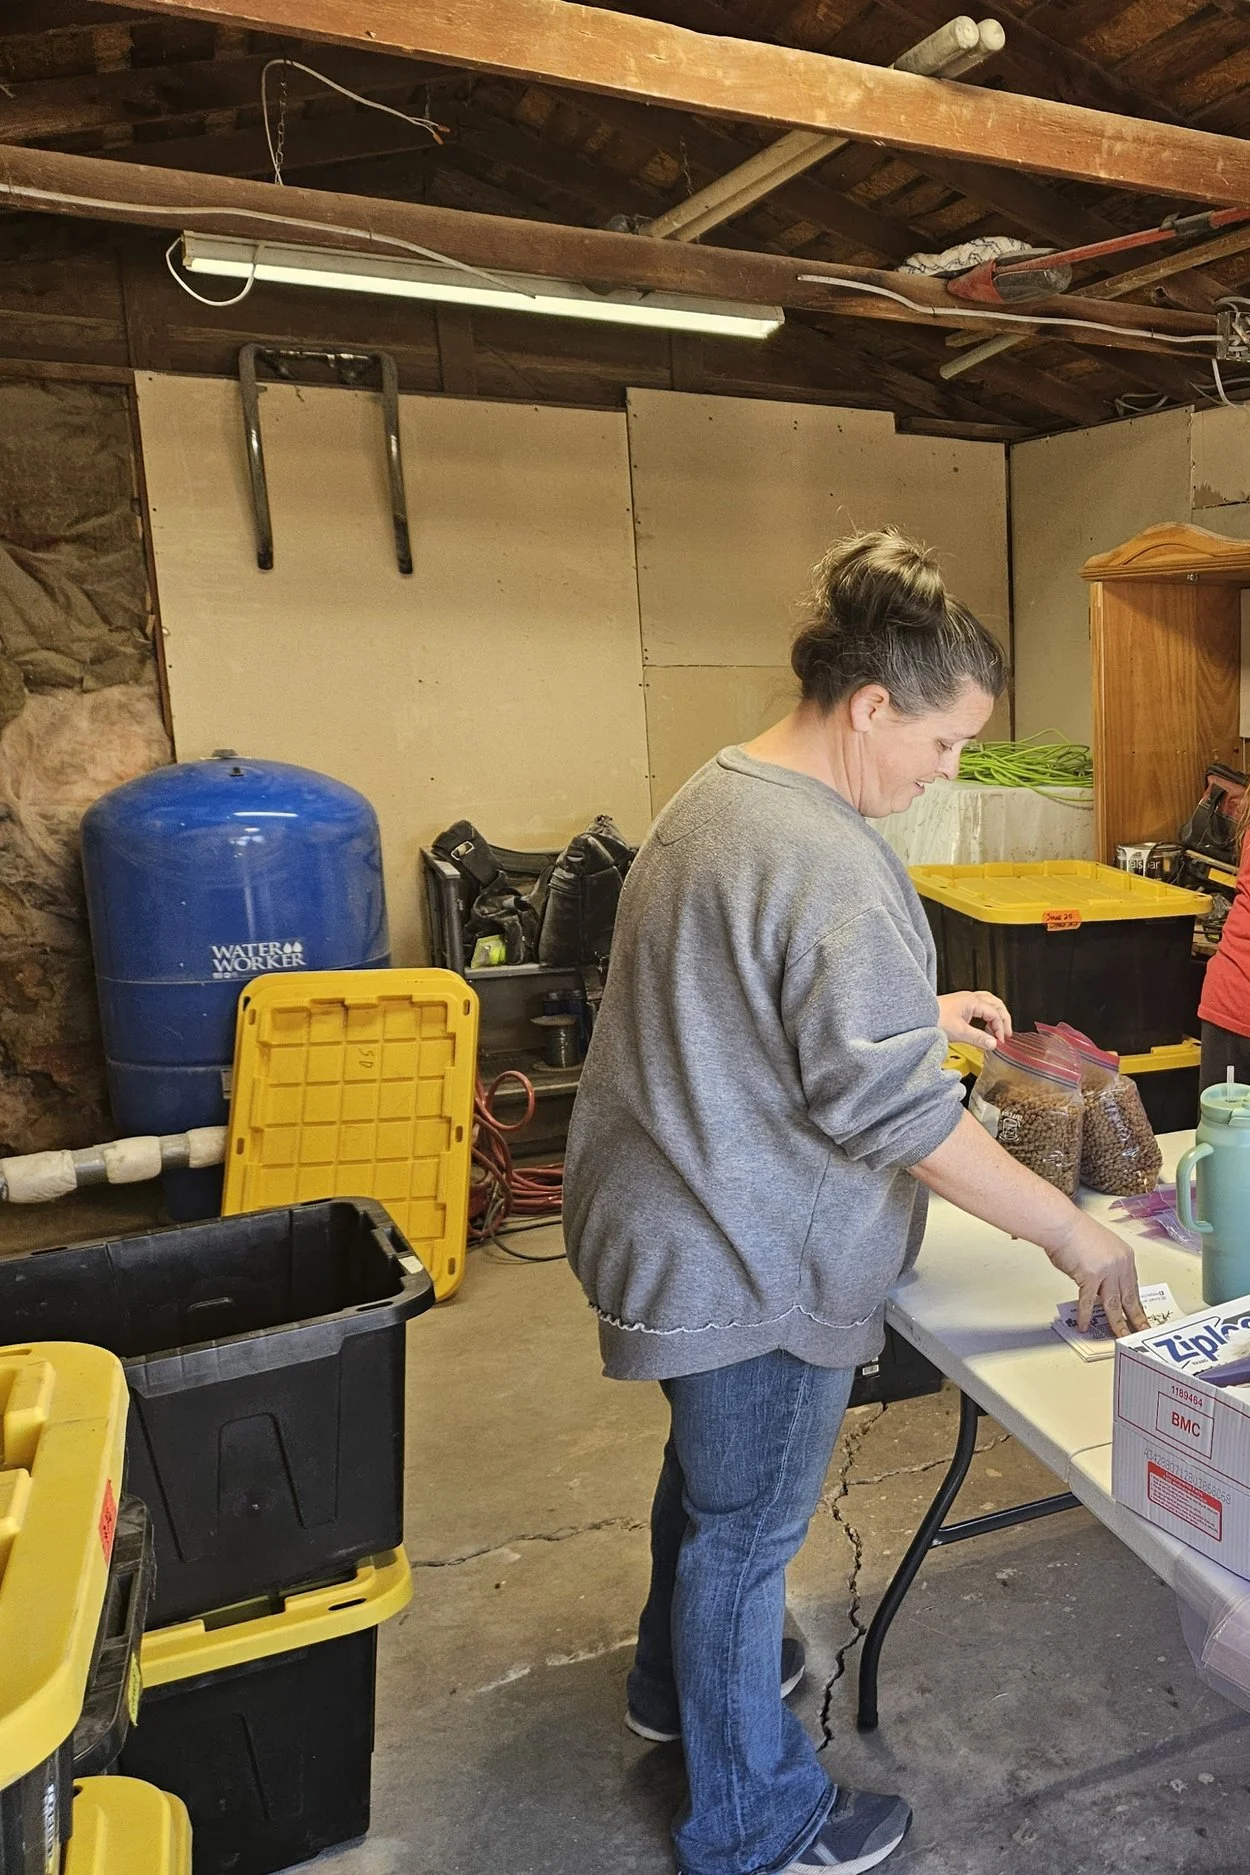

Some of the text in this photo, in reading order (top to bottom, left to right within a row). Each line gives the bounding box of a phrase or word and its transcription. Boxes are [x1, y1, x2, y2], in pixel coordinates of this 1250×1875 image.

[212, 942, 283, 959] WATER
[212, 953, 307, 972] WORKER
[1171, 1411, 1201, 1437] BMC
